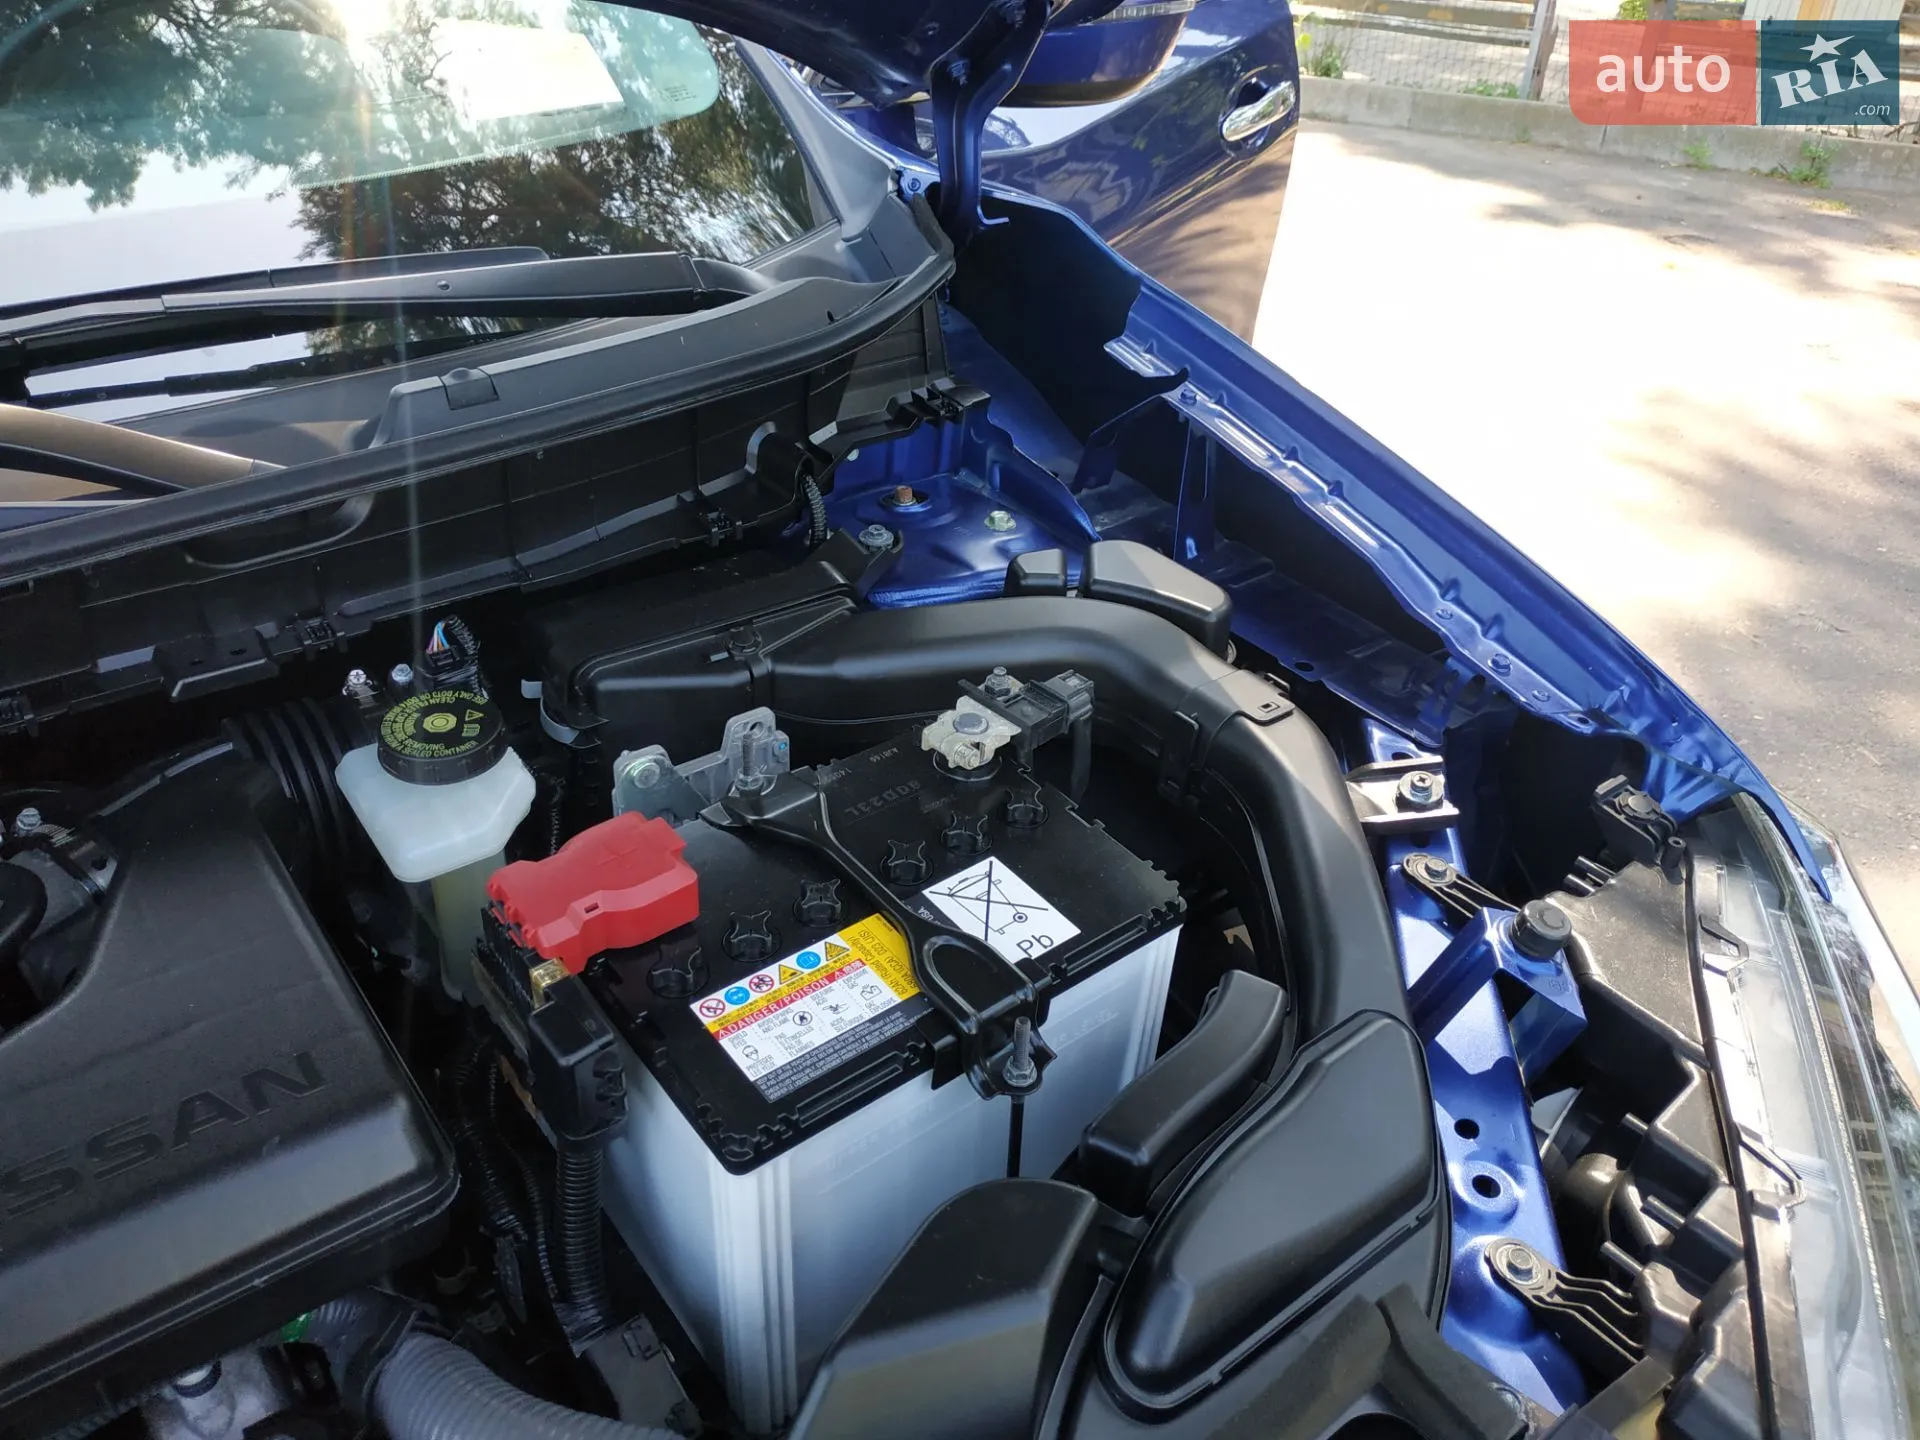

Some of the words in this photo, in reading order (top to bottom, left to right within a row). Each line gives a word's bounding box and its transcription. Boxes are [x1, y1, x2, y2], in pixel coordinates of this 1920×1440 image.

[426, 697, 456, 705] CLEAN
[433, 690, 453, 698] DOT3
[454, 690, 474, 699] ONLY
[400, 745, 432, 757] SEALED
[404, 739, 445, 751] REMOVING
[434, 741, 479, 757] CONTAINER
[918, 905, 934, 921] USA
[858, 930, 875, 944] (JIS)
[849, 937, 875, 961] Capacity)
[1016, 934, 1054, 957] Pb
[885, 956, 904, 974] (CCA)
[889, 978, 907, 995] 62Ah
[726, 976, 830, 1032] DANGER/POISON
